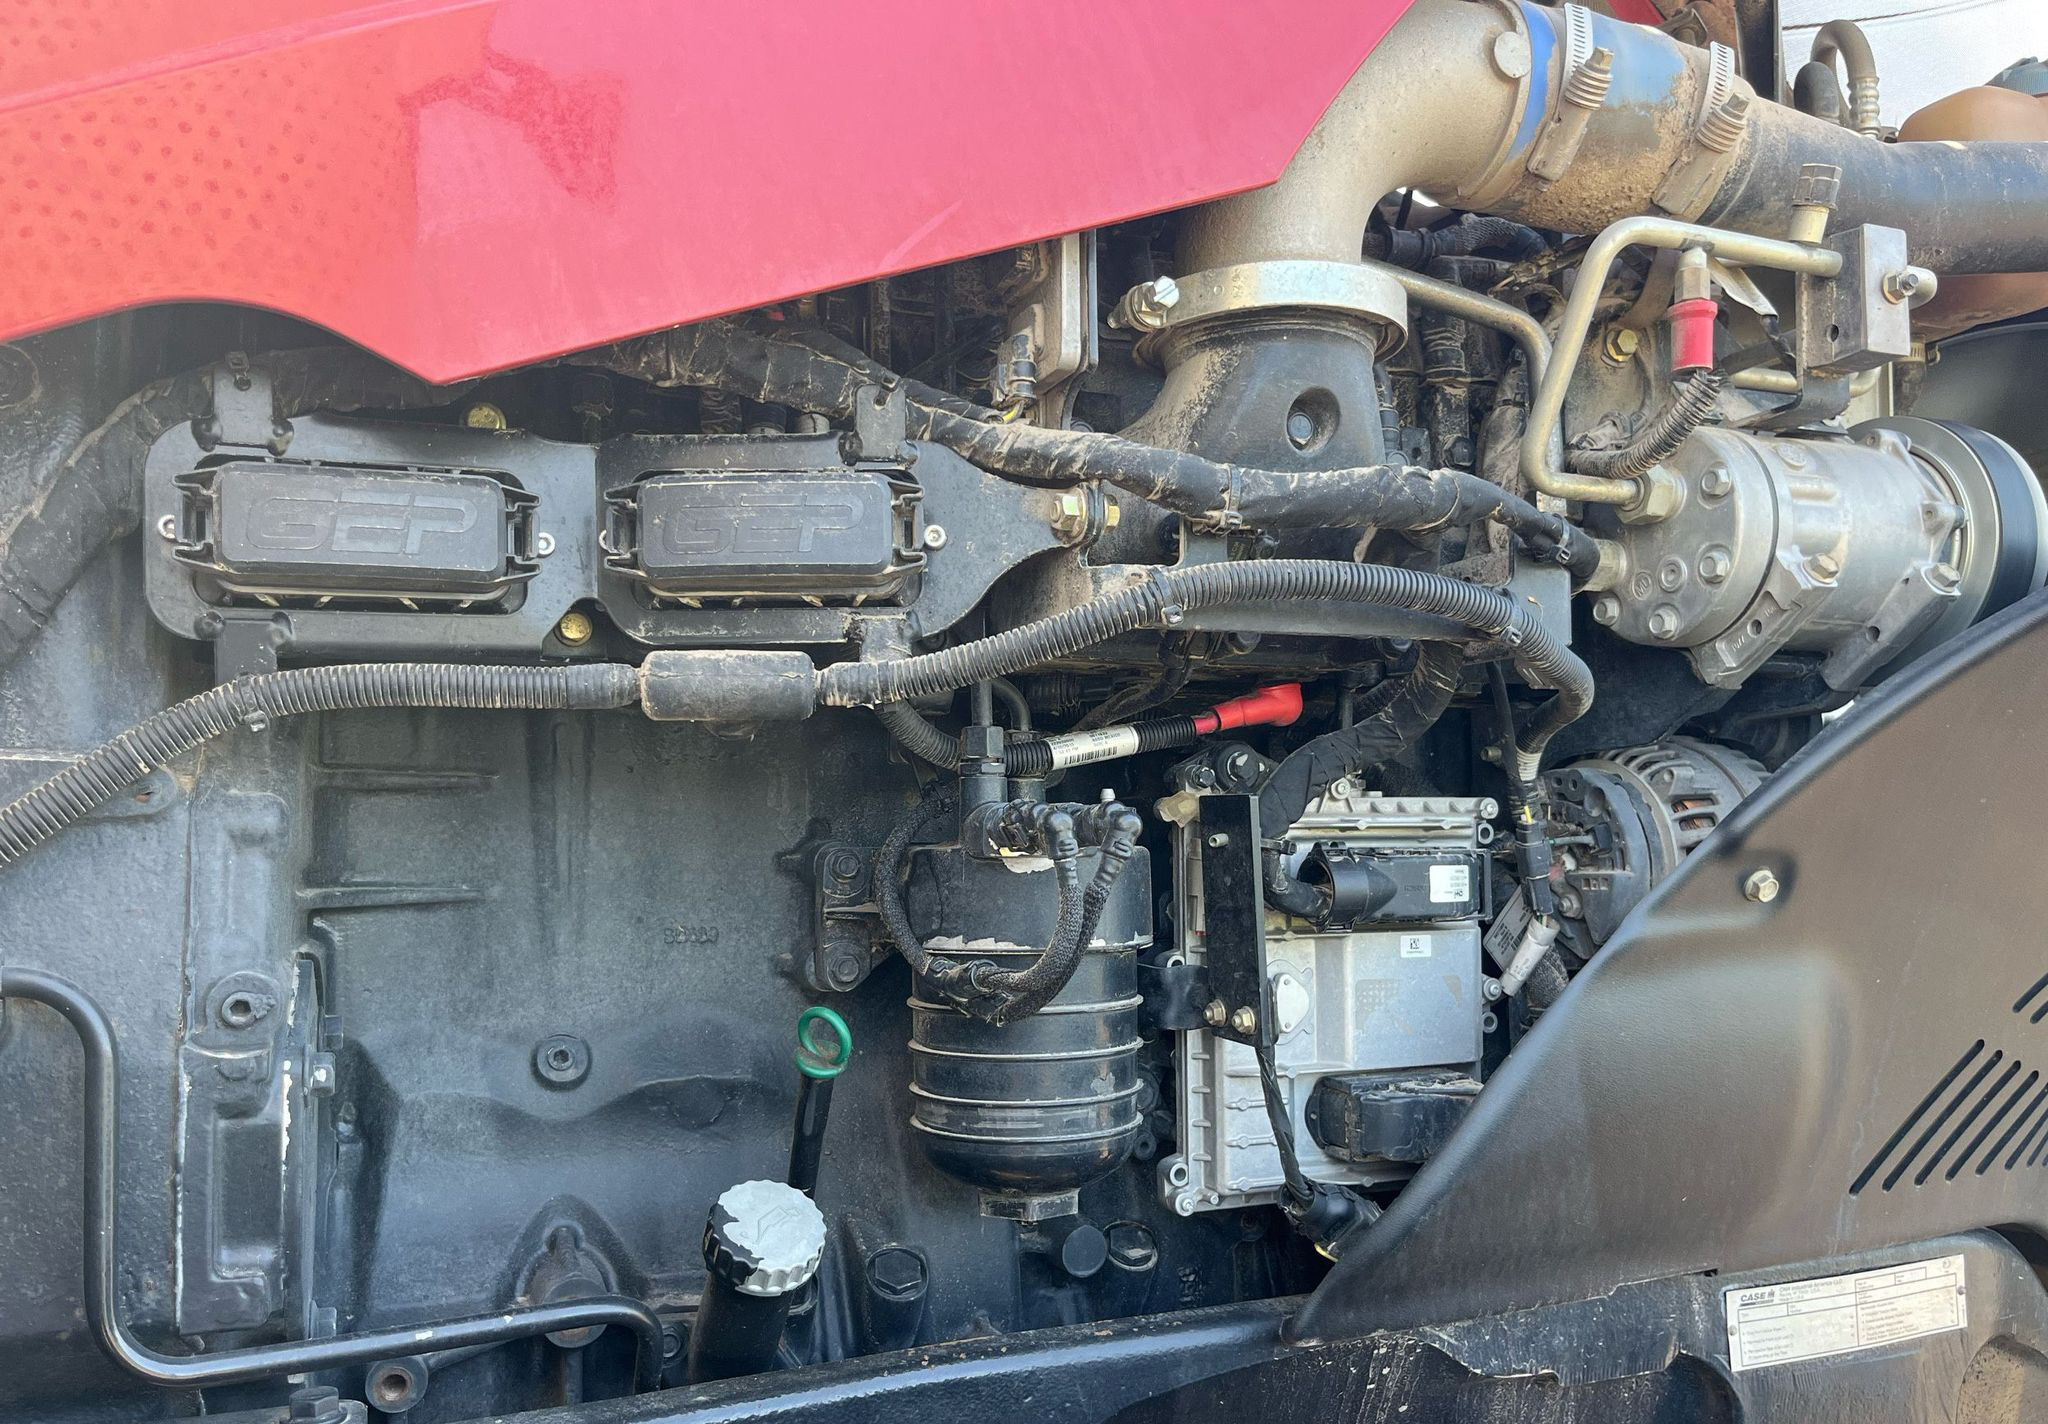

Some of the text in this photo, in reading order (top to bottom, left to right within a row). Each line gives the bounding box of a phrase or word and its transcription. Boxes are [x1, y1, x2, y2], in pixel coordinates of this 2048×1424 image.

[246, 488, 478, 555] GEP
[662, 494, 865, 556] GEP
[1740, 1292, 1767, 1303] CASE
